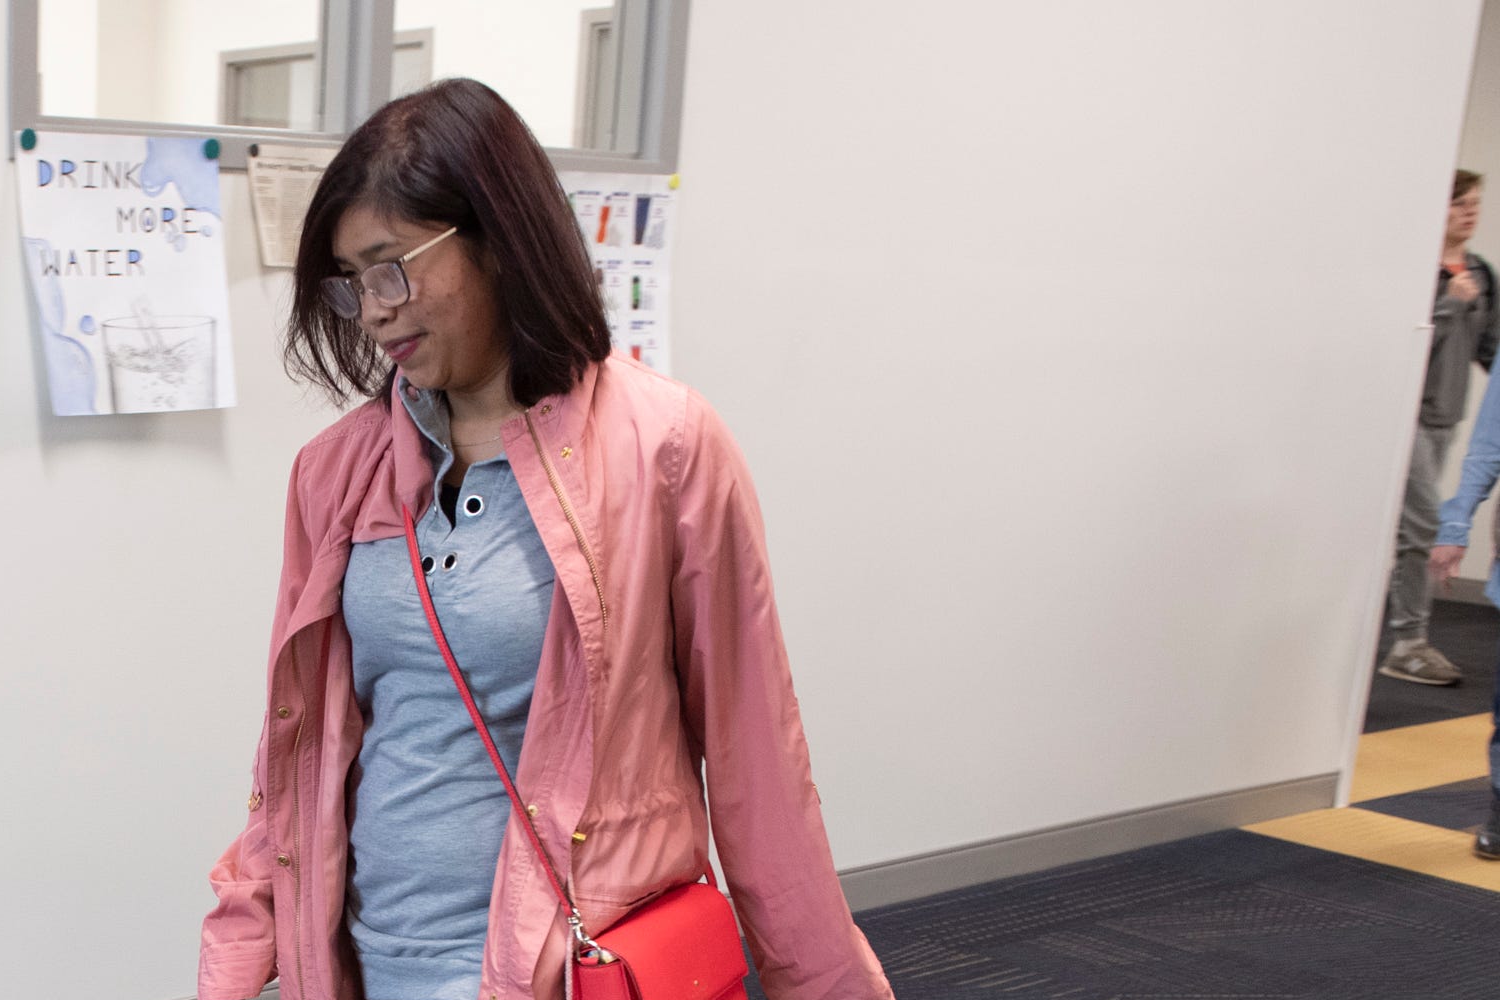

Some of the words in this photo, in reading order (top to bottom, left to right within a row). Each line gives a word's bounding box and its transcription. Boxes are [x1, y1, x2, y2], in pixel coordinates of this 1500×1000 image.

[37, 159, 143, 189] DRINK
[116, 206, 200, 234] MORE
[40, 248, 145, 277] WATER
